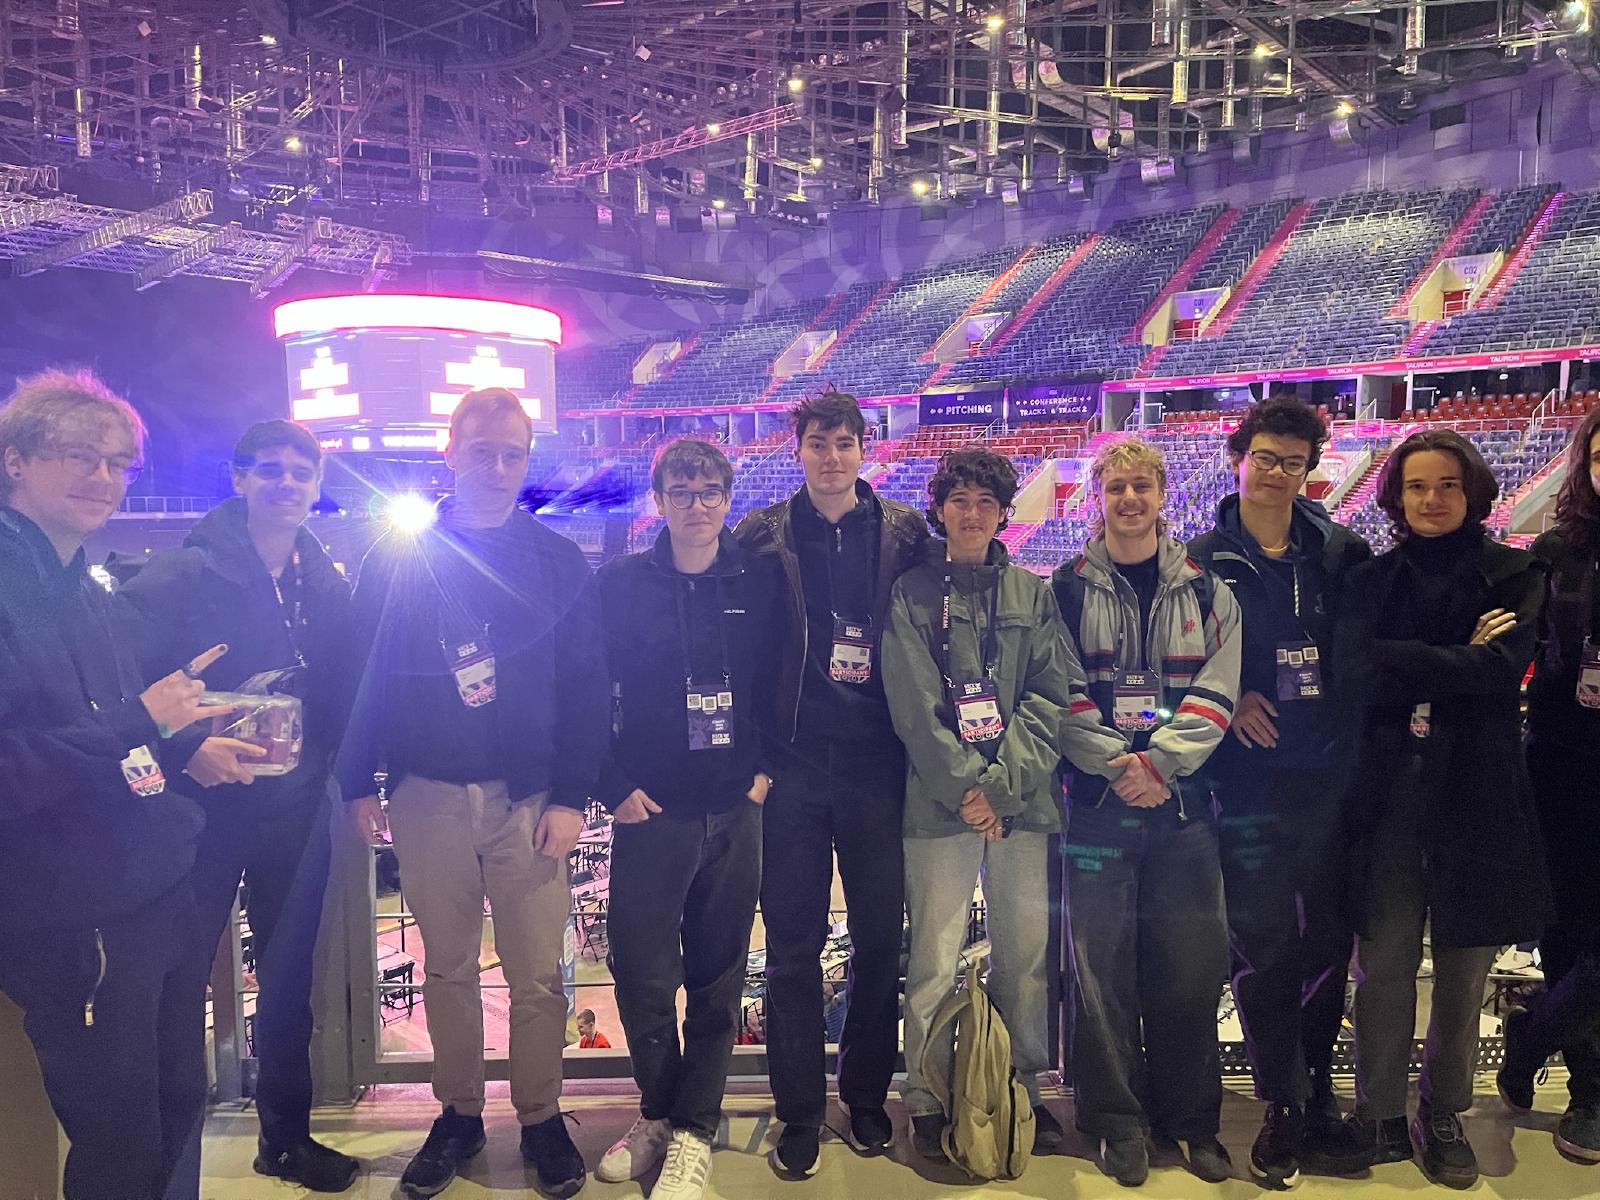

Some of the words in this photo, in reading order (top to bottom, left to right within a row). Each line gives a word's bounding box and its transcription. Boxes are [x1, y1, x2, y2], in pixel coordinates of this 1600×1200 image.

[1489, 354, 1520, 363] TAURON
[1405, 361, 1434, 369] TAURON
[1327, 367, 1353, 375] TAURON
[1256, 373, 1281, 381] TAURON
[1030, 396, 1077, 406] CONFERENCE
[946, 404, 993, 415] PITCHING
[831, 669, 868, 677] PARTICIPANT
